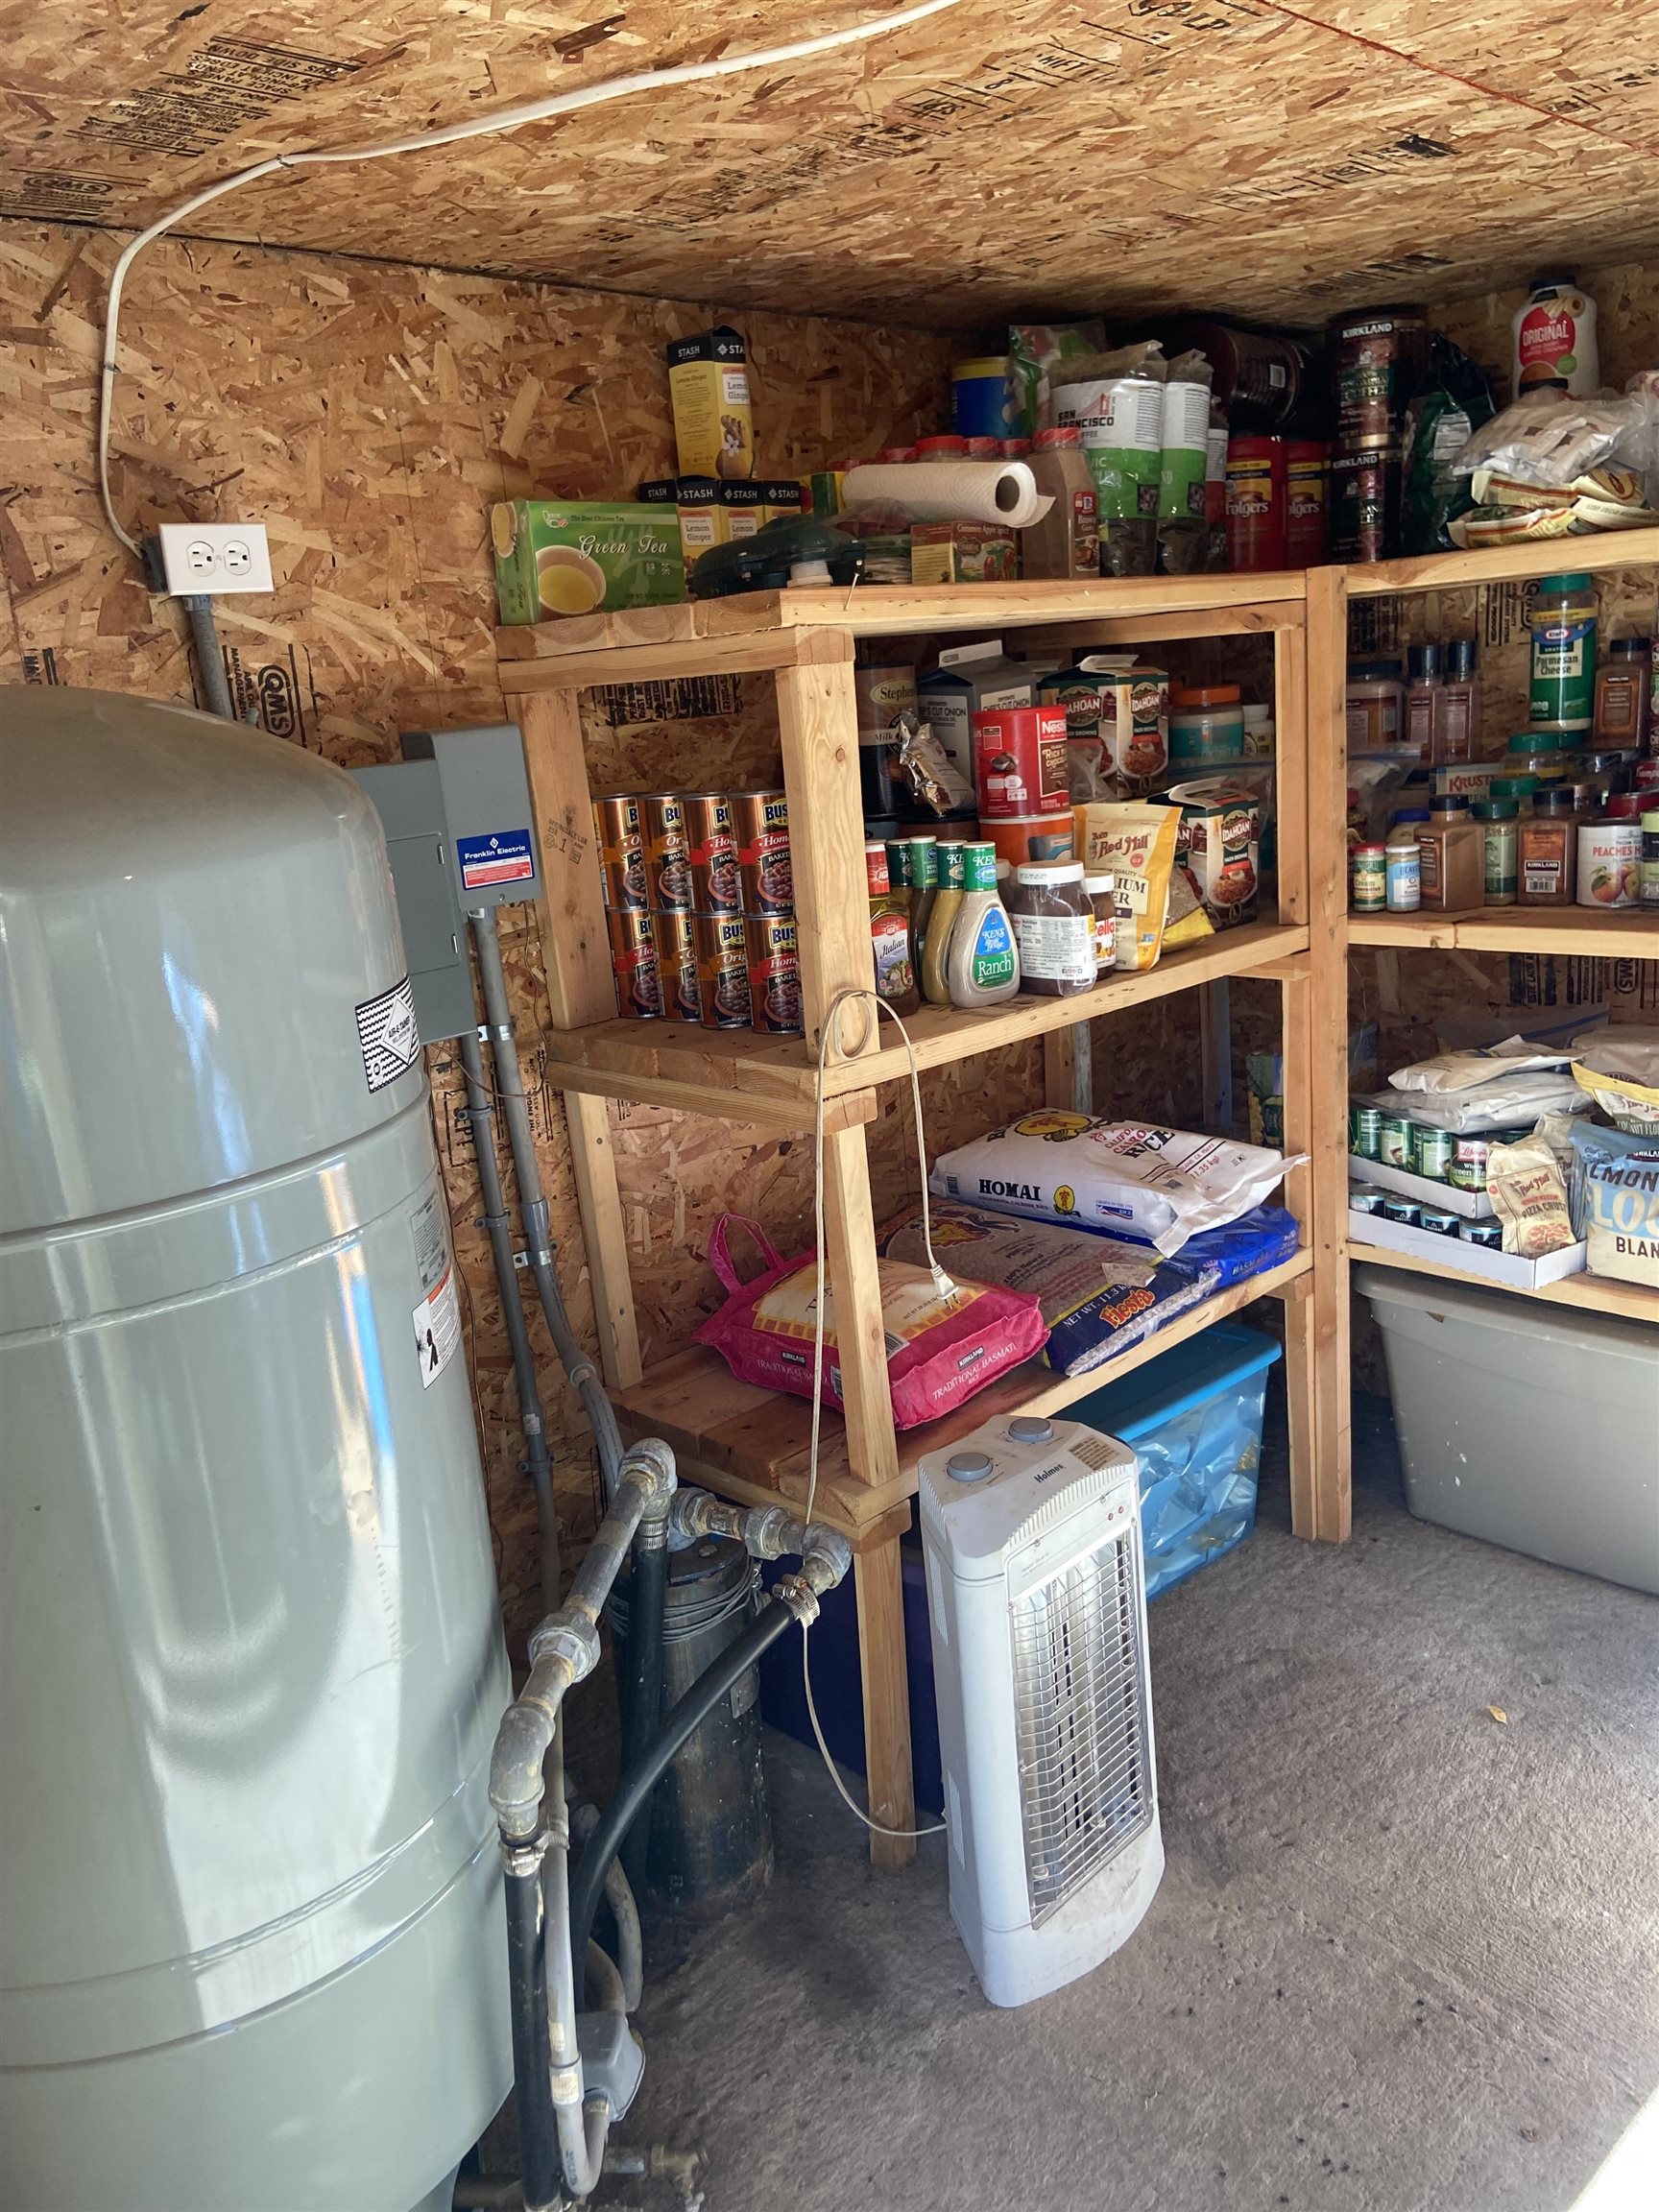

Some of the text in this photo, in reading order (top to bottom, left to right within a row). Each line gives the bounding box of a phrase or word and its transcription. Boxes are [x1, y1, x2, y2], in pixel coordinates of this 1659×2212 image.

[265, 55, 302, 69] SIDE
[1343, 323, 1392, 339] KIRKLAND
[1523, 323, 1570, 347] ORIGINAL
[678, 346, 700, 357] STASH
[1058, 410, 1075, 420] SAN
[1058, 417, 1114, 429] FRANCISCO
[1333, 455, 1379, 469] KIRKLAND
[648, 487, 667, 498] STASH
[683, 488, 713, 499] STASH
[733, 489, 757, 500] STASH
[778, 488, 799, 499] STASH
[1226, 500, 1268, 517] Folgers
[685, 524, 710, 534] Lemon
[732, 524, 755, 534] Lemon
[687, 533, 712, 543] Ginger
[579, 535, 669, 560] Green Tea
[1536, 656, 1578, 667] Parmesan
[1540, 665, 1572, 676] Cheese
[265, 672, 291, 732] QMS
[1001, 702, 1012, 710] CUT
[1012, 699, 1030, 708] ONION
[1132, 694, 1160, 713] IDAHOAN
[932, 708, 966, 717] CUT ONION
[874, 733, 893, 742] Milk
[1222, 819, 1251, 841] IDAHOAN
[465, 845, 525, 860] Franklin Electric
[1097, 834, 1149, 860] Red Mill
[1593, 846, 1632, 857] PEACHES
[1115, 868, 1137, 877] QUALITY
[879, 937, 904, 959] Italian
[978, 953, 1012, 977] Ranch
[979, 1179, 1041, 1201] HOMAI
[1119, 1209, 1132, 1217] RICE
[1522, 1202, 1566, 1219] PIZZA CRUST
[1063, 1314, 1083, 1328] NET
[1083, 1302, 1101, 1315] WT.
[1099, 1287, 1119, 1303] 11.3
[1100, 1289, 1155, 1329] Fiesta
[781, 1351, 806, 1364] KIRKLAND
[959, 1347, 984, 1367] KIRKLAND
[757, 1358, 803, 1377] TRADITIONAL
[932, 1343, 1017, 1401] TRADITIONAL BASMATI
[1034, 1463, 1064, 1483] Holmes
